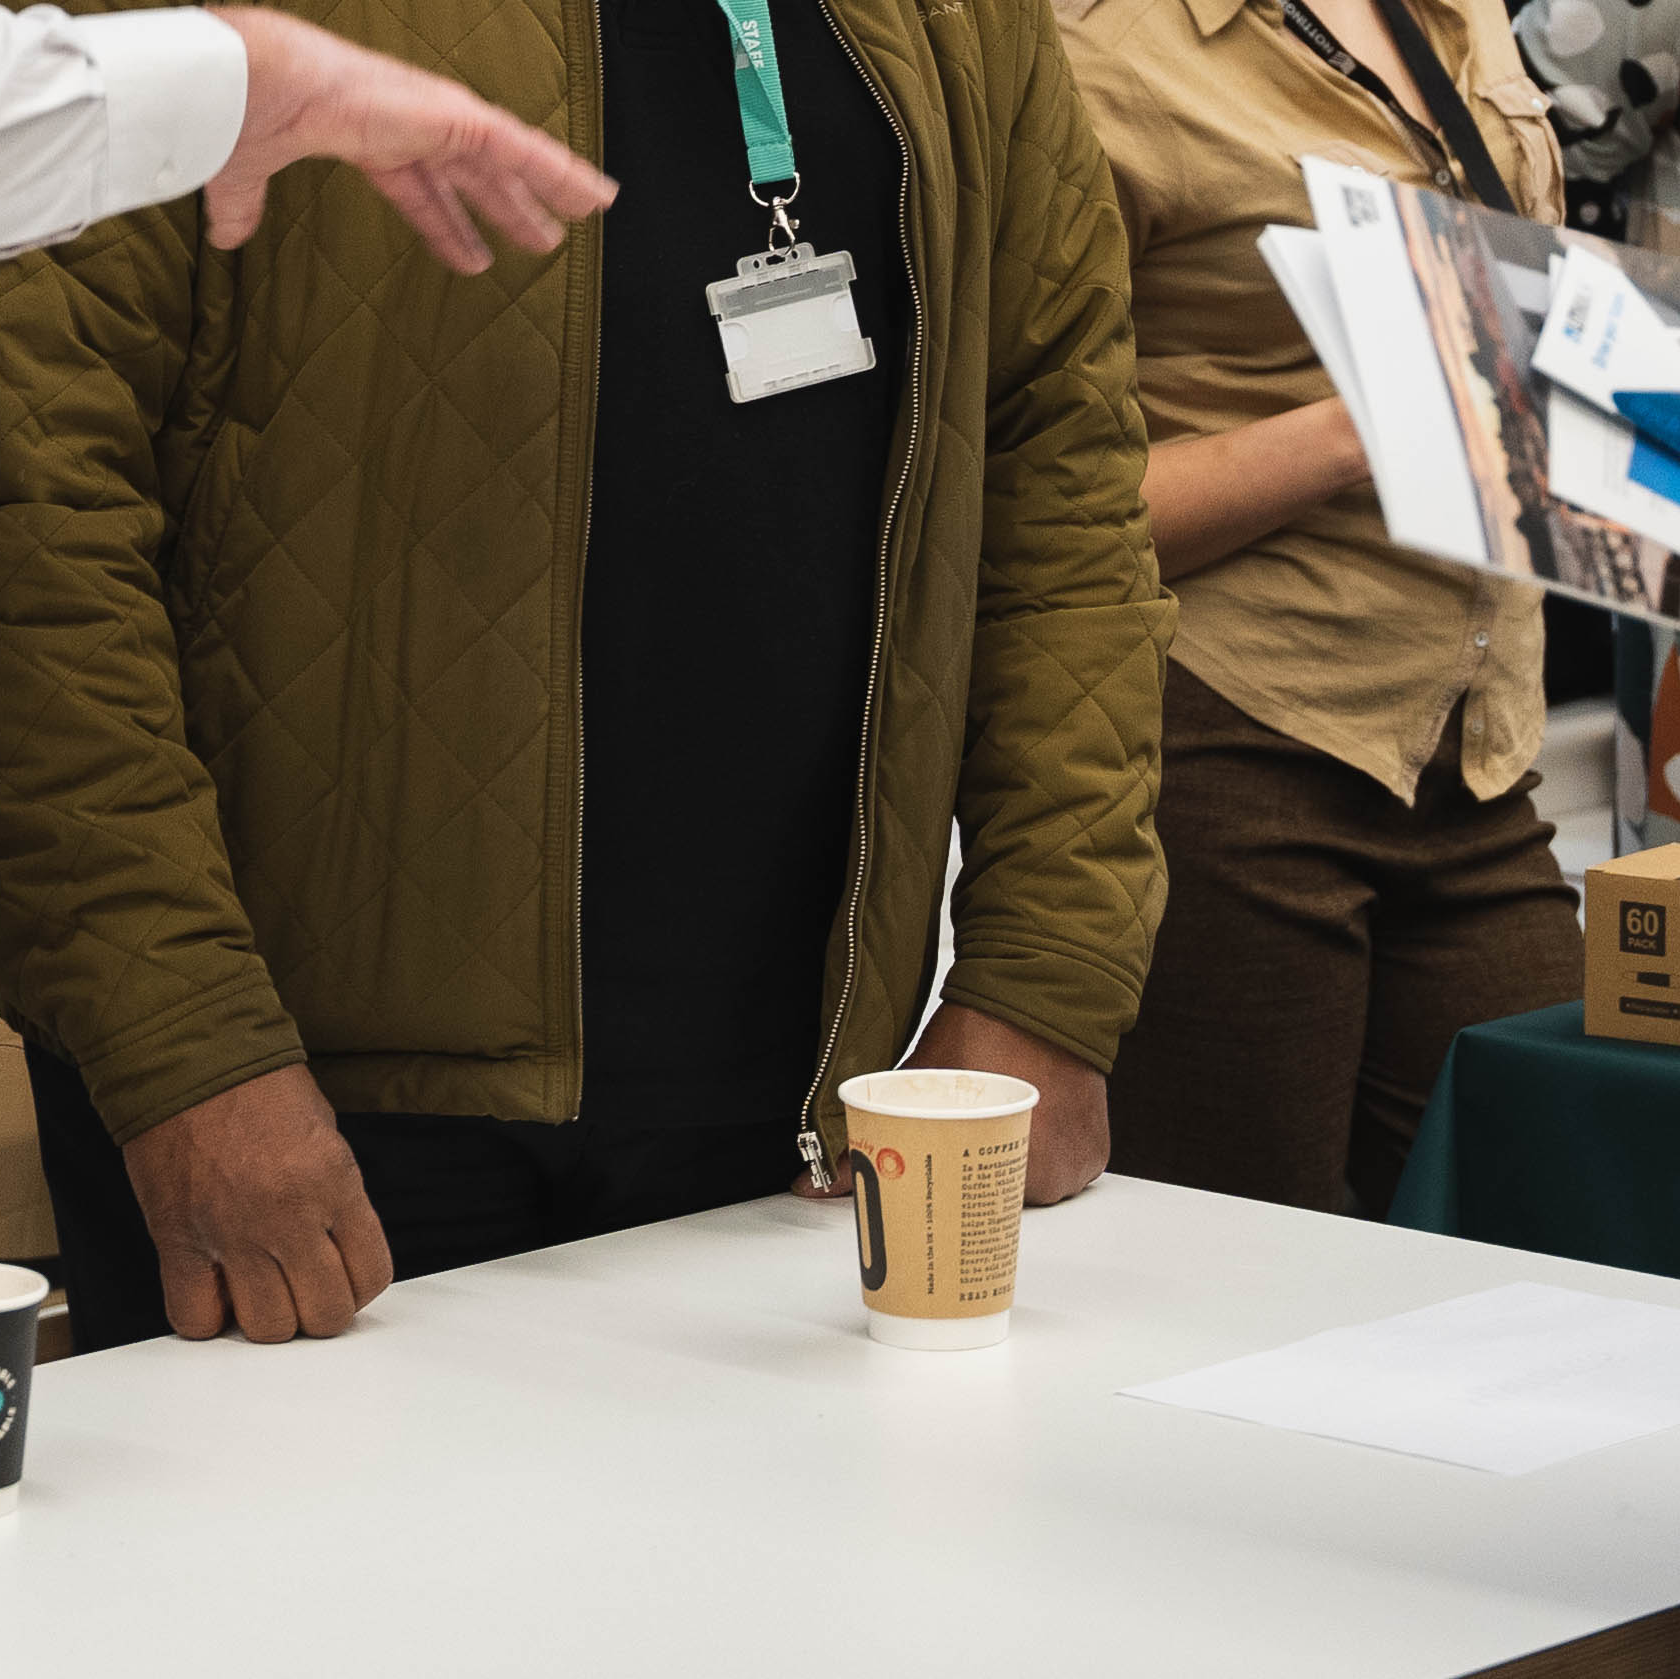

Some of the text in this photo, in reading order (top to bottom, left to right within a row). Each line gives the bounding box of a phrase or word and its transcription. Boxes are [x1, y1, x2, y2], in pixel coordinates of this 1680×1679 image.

[1626, 907, 1659, 936] 60
[1627, 936, 1657, 951] PACK
[959, 1290, 988, 1301] READ
